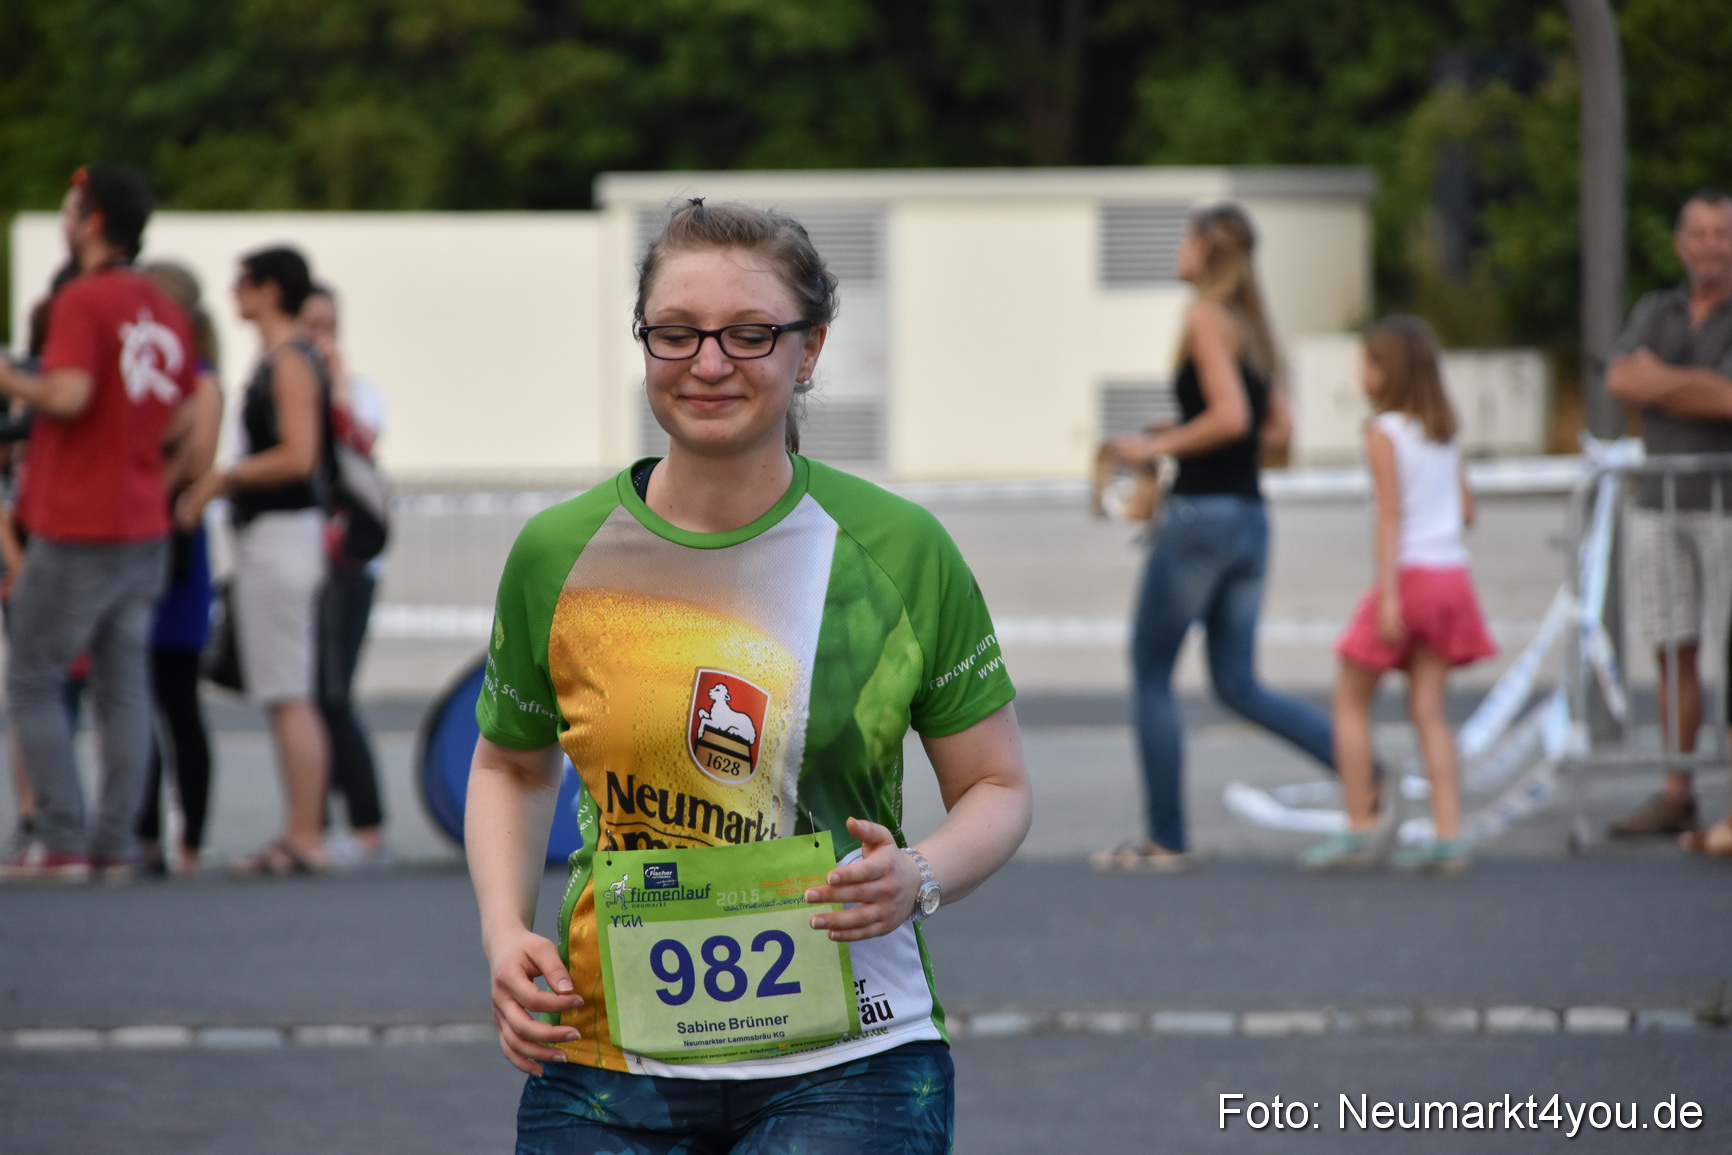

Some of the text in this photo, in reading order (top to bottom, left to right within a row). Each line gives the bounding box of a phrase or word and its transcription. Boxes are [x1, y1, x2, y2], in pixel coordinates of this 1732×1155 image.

[706, 752, 741, 776] 1628
[650, 869, 673, 877] Fischer
[631, 883, 711, 902] firmenlauf
[716, 889, 760, 906] 2015
[650, 929, 801, 1006] 982
[677, 1014, 789, 1034] Sabine Brünner
[684, 1031, 785, 1047] Neumarkter Lammsbräu KG
